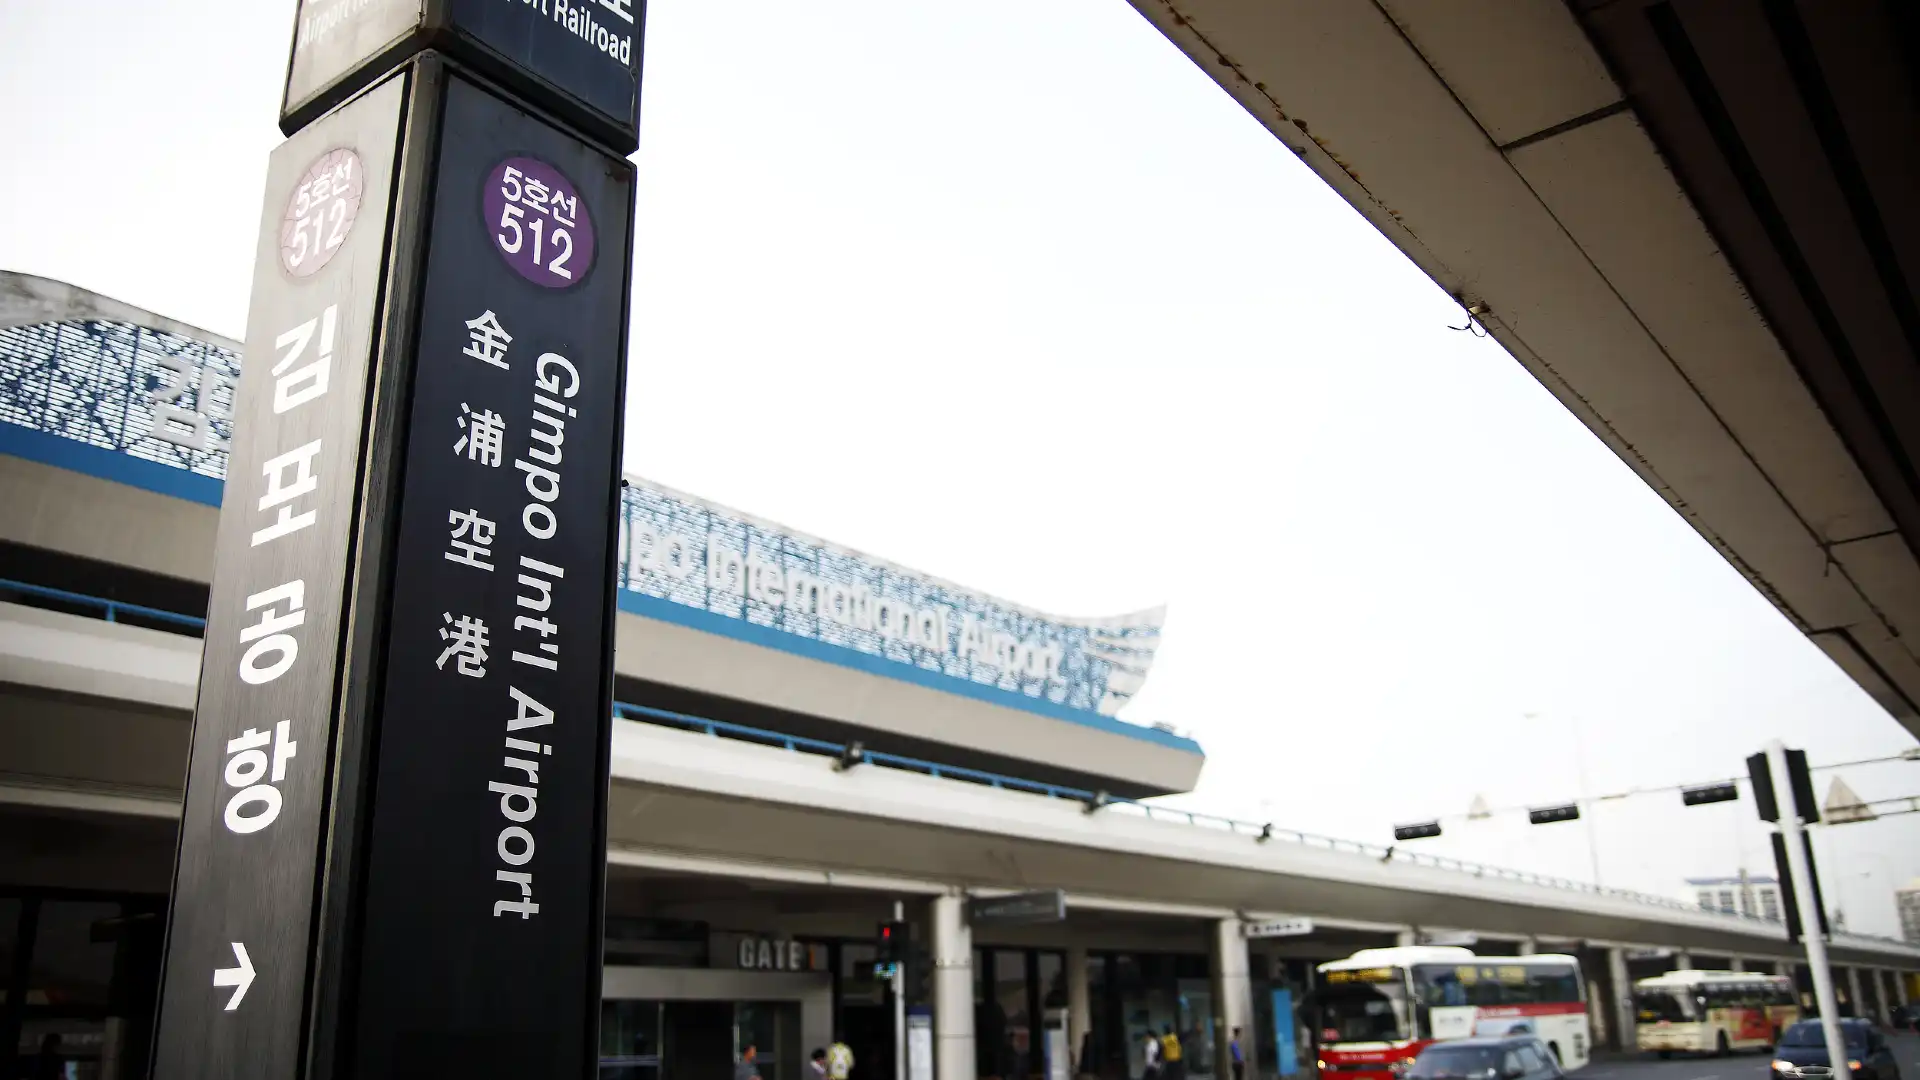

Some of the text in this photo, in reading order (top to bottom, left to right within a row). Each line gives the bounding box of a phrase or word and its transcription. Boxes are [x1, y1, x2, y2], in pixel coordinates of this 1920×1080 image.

[553, 0, 632, 67] Railroad
[295, 156, 354, 218] 5호선
[500, 164, 578, 229] 5호선
[289, 197, 348, 268] 512
[497, 203, 573, 280] 512
[435, 308, 514, 679] 金浦空港
[223, 303, 339, 835] 김포공항
[488, 351, 581, 920] Gimpo Int'l Airport
[706, 530, 950, 656] International
[956, 611, 1068, 685] Airport
[739, 938, 803, 970] GATE
